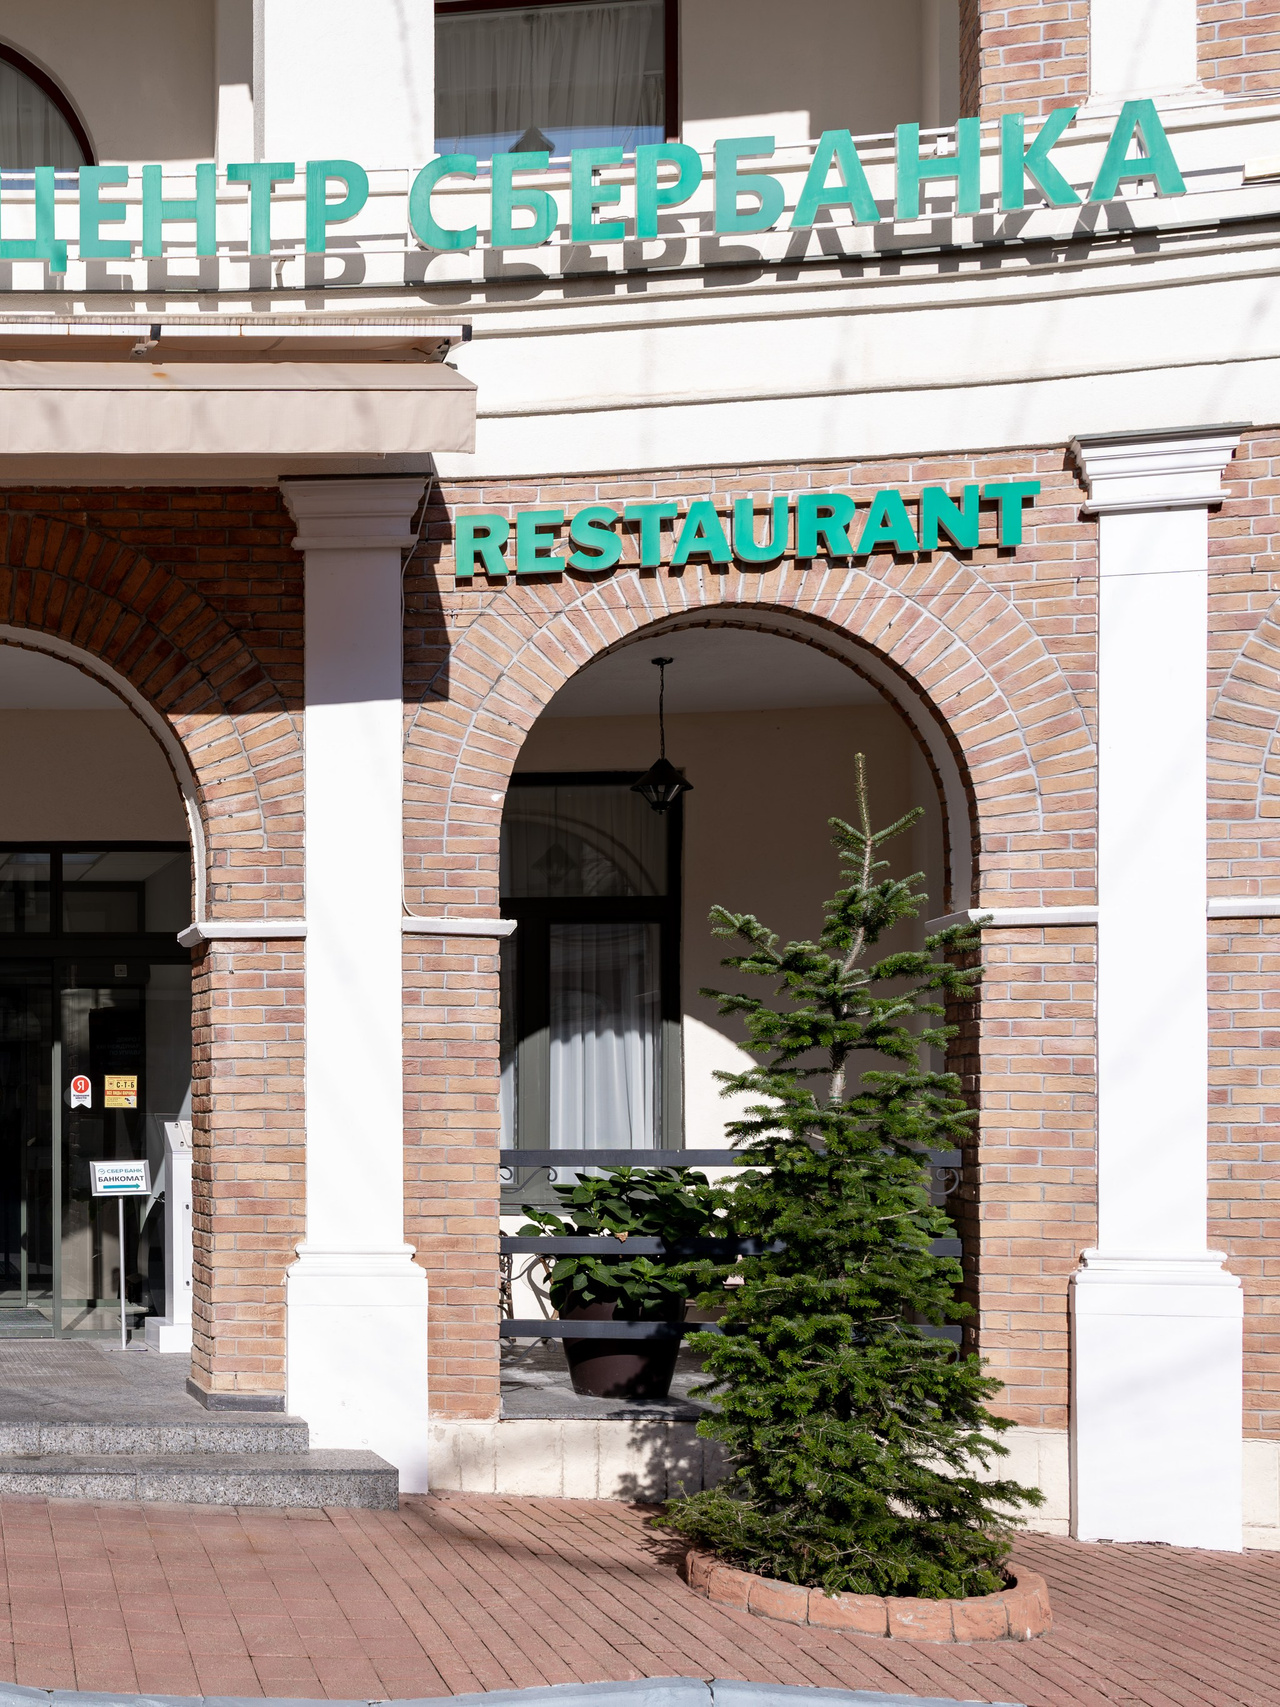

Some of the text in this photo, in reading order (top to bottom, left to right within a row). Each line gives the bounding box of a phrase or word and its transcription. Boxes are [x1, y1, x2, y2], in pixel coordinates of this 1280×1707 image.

[408, 98, 1186, 252] СБЕРБАНКА
[455, 481, 1041, 578] RESTAURANT
[77, 1080, 85, 1091] Я
[98, 1175, 145, 1183] БАНКОМАТ
